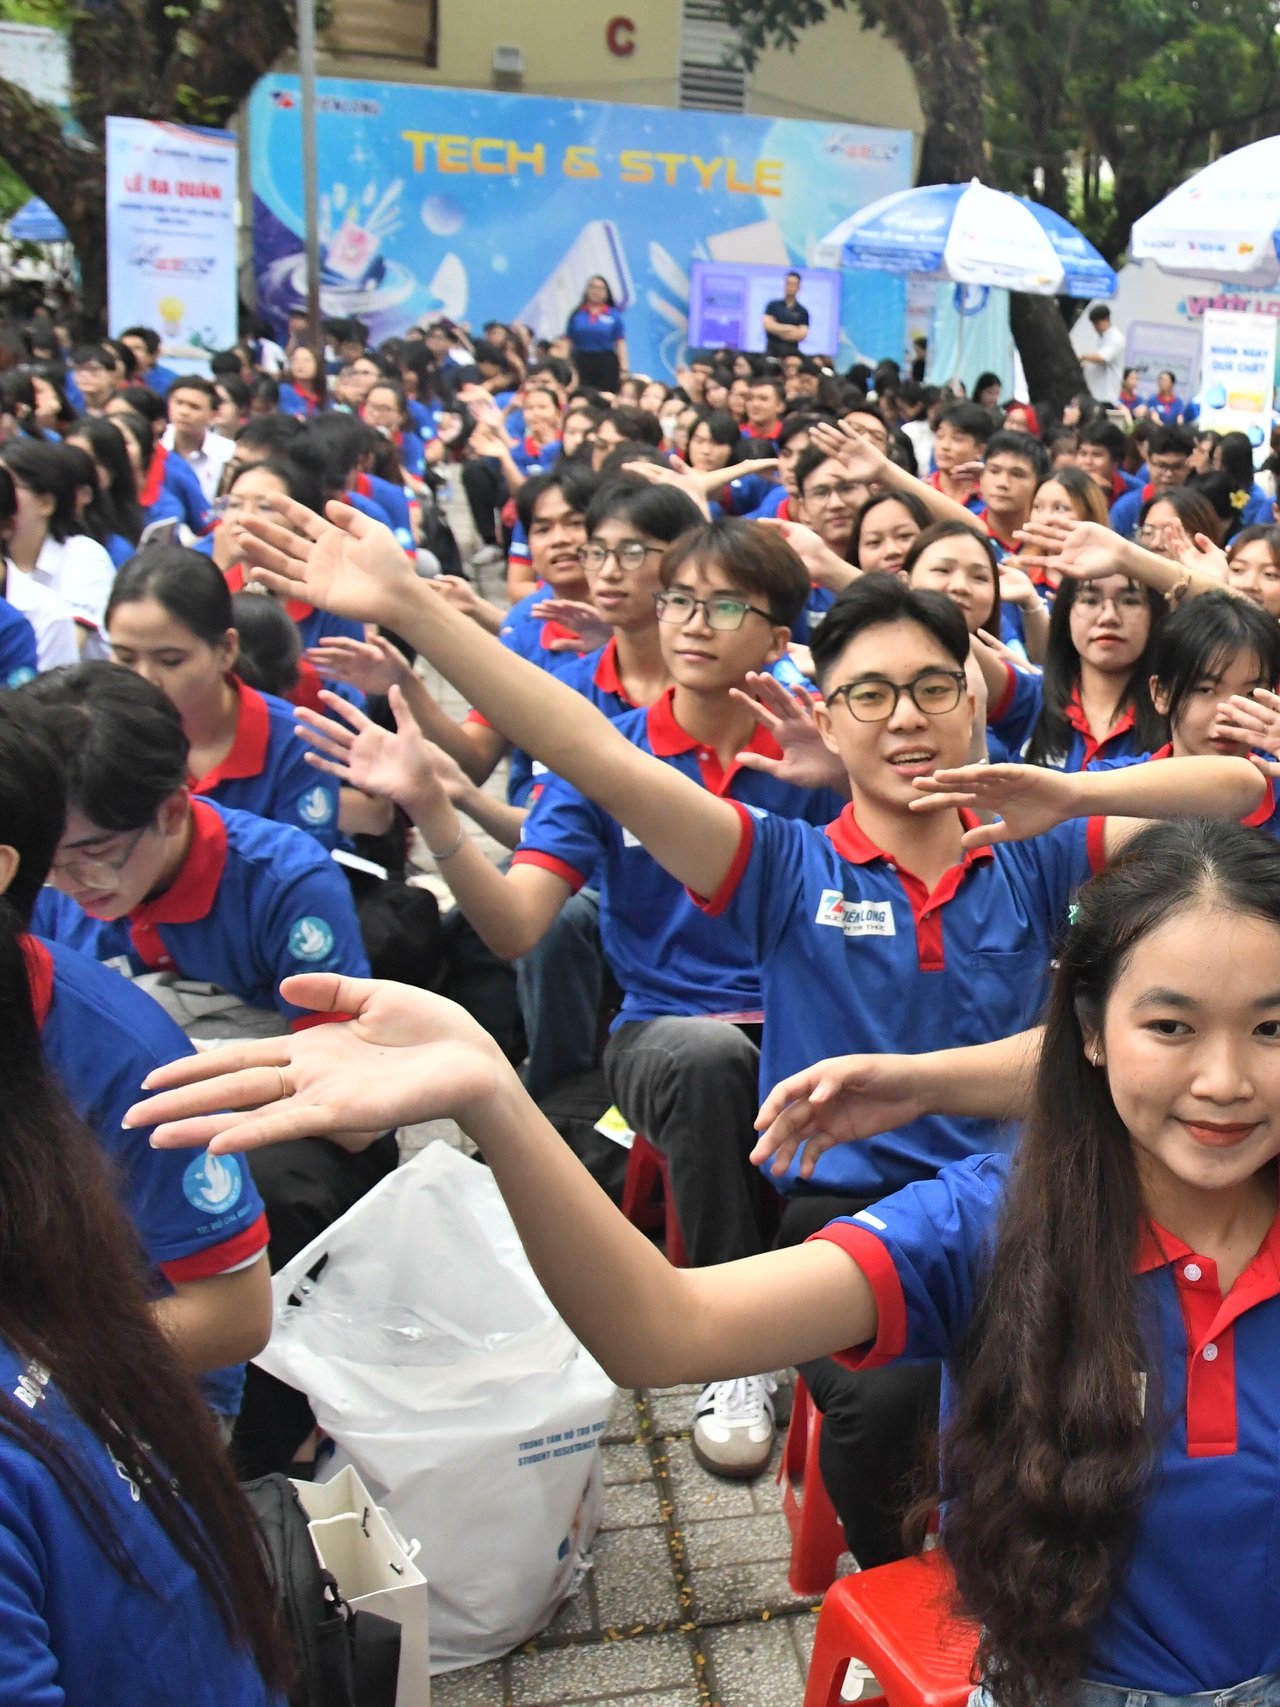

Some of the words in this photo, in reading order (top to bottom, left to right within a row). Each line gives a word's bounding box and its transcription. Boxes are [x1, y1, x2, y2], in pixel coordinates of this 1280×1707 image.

[605, 16, 635, 58] C
[401, 130, 544, 176] TECH
[562, 145, 599, 179] &
[619, 150, 784, 197] STYLE
[861, 909, 886, 922] LONG
[518, 1451, 549, 1466] STUDENT
